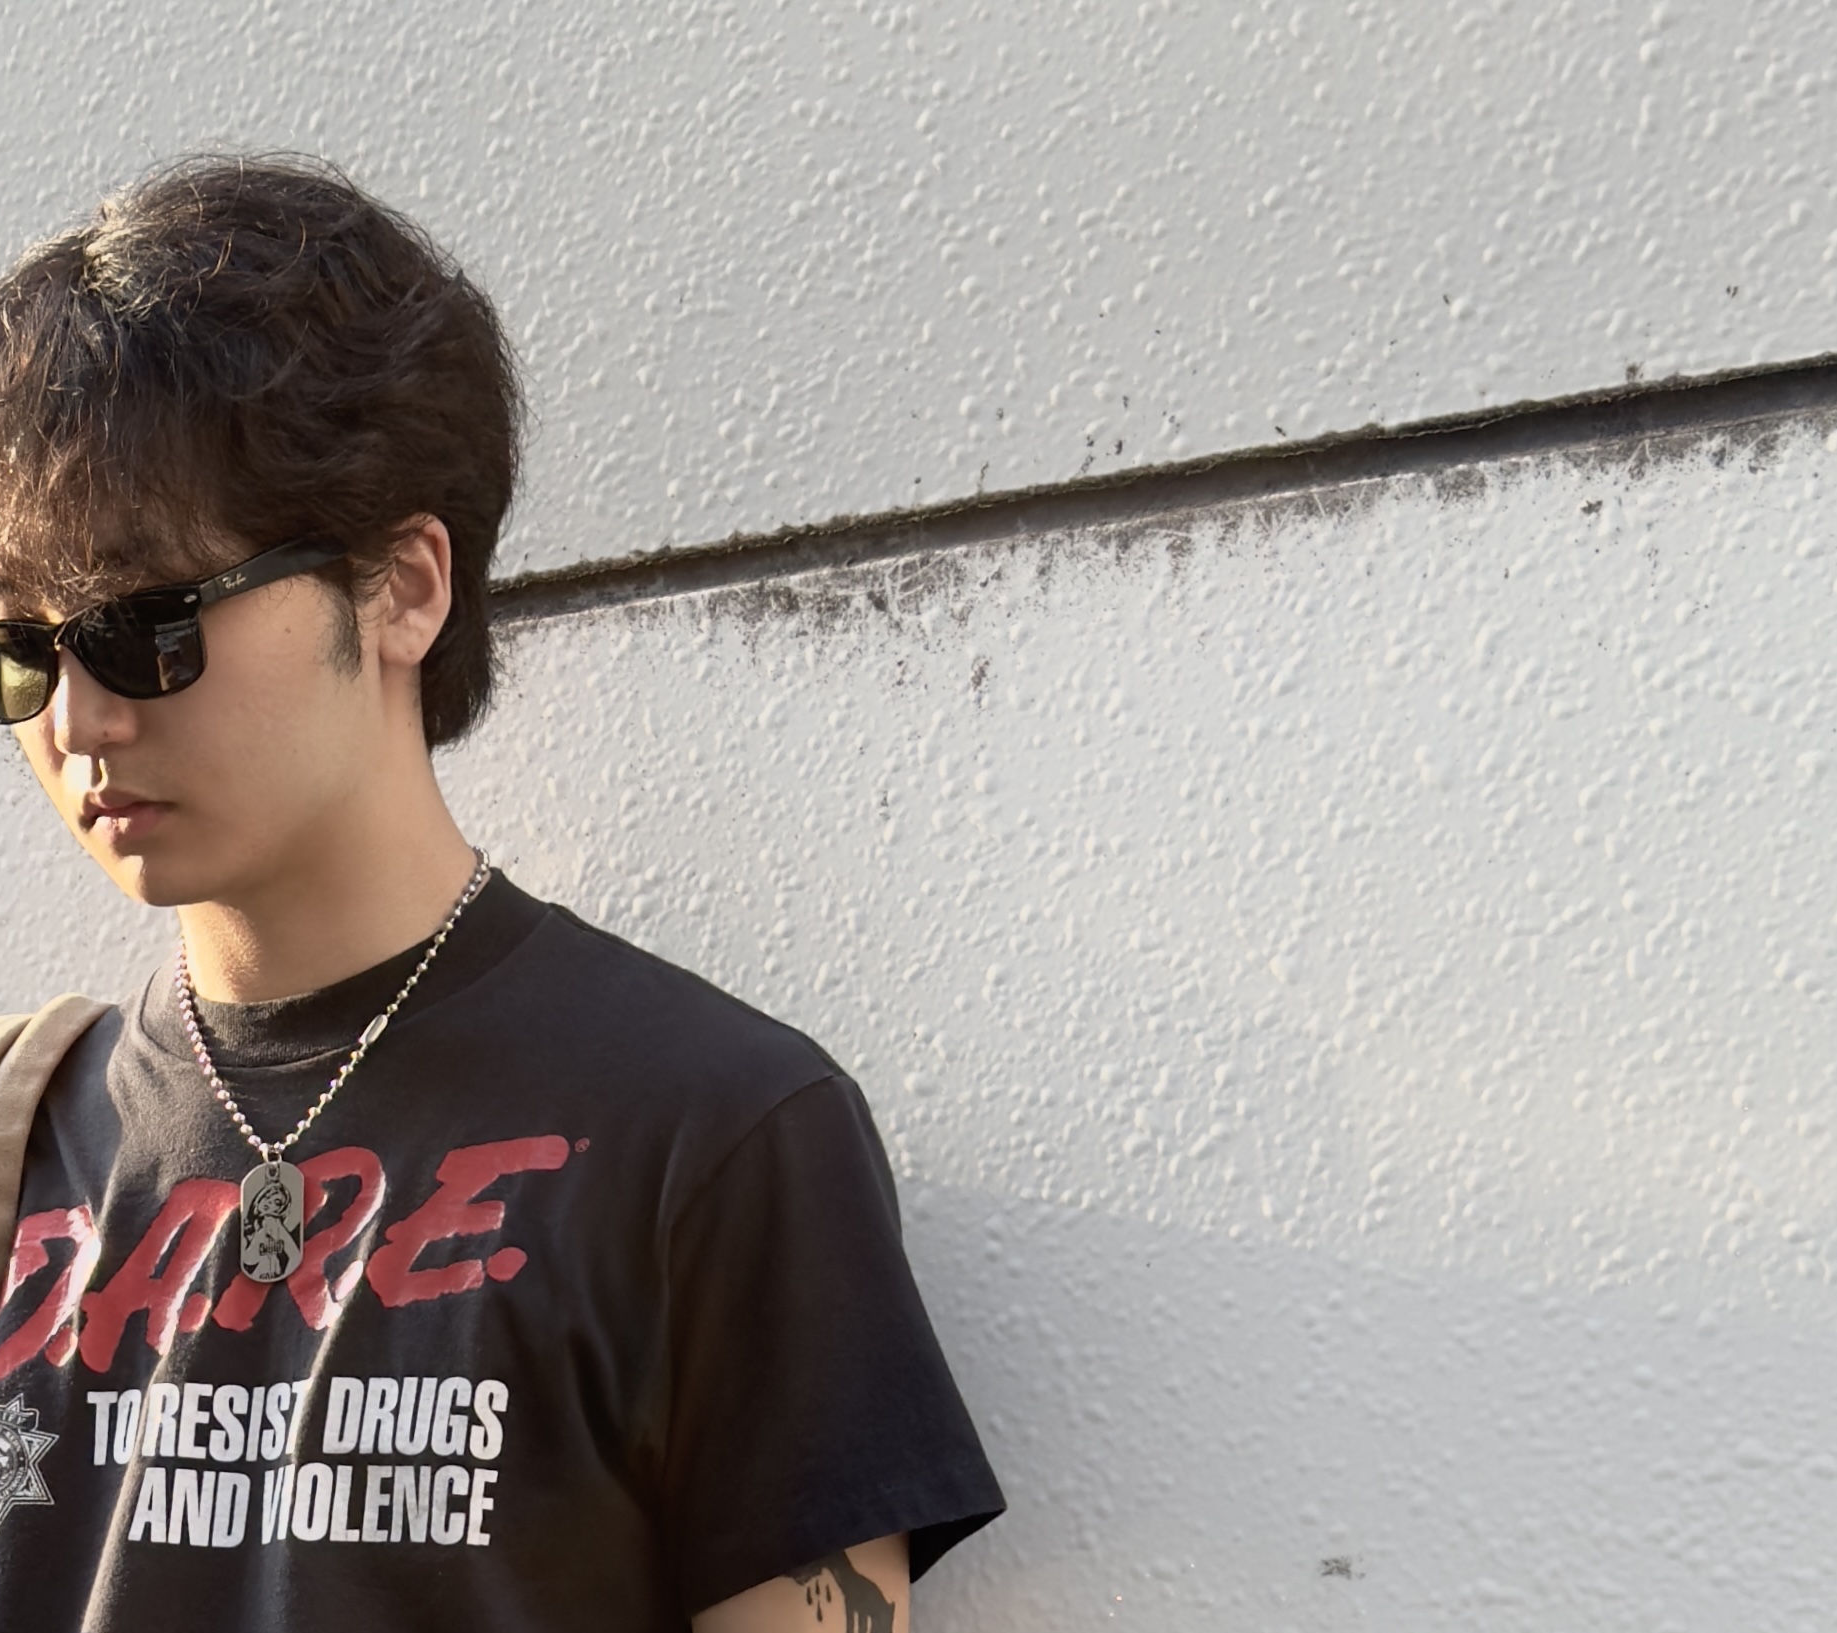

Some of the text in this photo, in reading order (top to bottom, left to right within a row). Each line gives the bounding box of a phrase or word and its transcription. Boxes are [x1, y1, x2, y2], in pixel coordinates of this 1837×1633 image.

[87, 1376, 509, 1466] TO RESIST DRUGS
[128, 1462, 498, 1547] AND VIOLENCE
